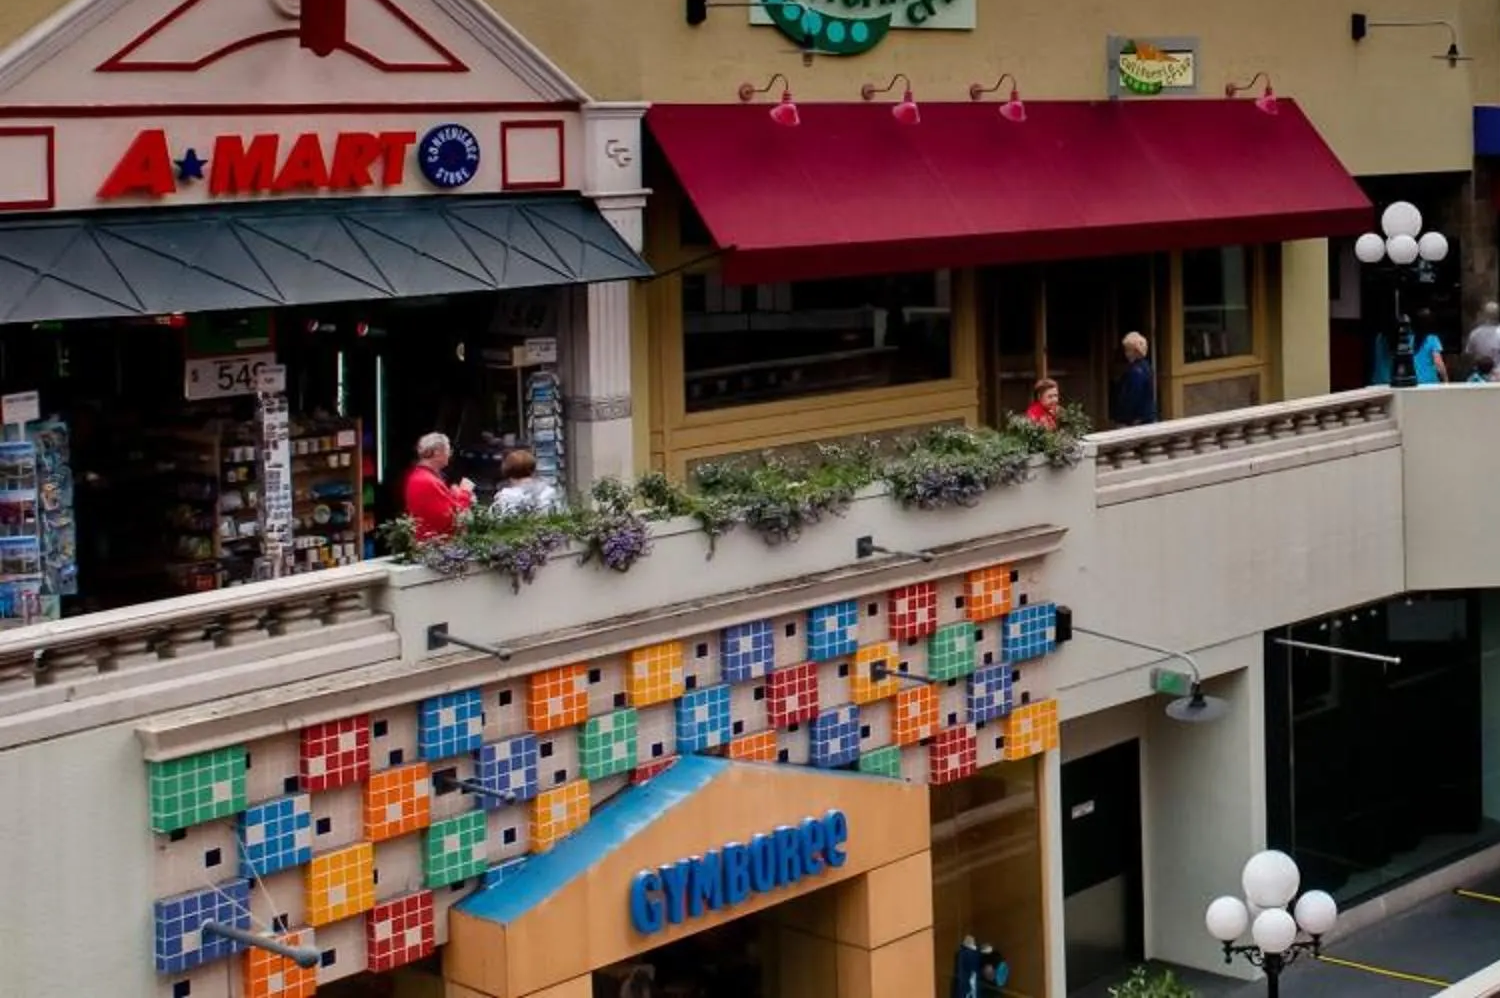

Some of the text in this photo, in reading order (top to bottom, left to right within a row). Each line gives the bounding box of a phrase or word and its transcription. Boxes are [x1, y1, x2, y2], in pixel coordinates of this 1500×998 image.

[427, 127, 478, 162] CONVENIENCE
[210, 131, 417, 197] MART
[435, 167, 470, 184] STORE
